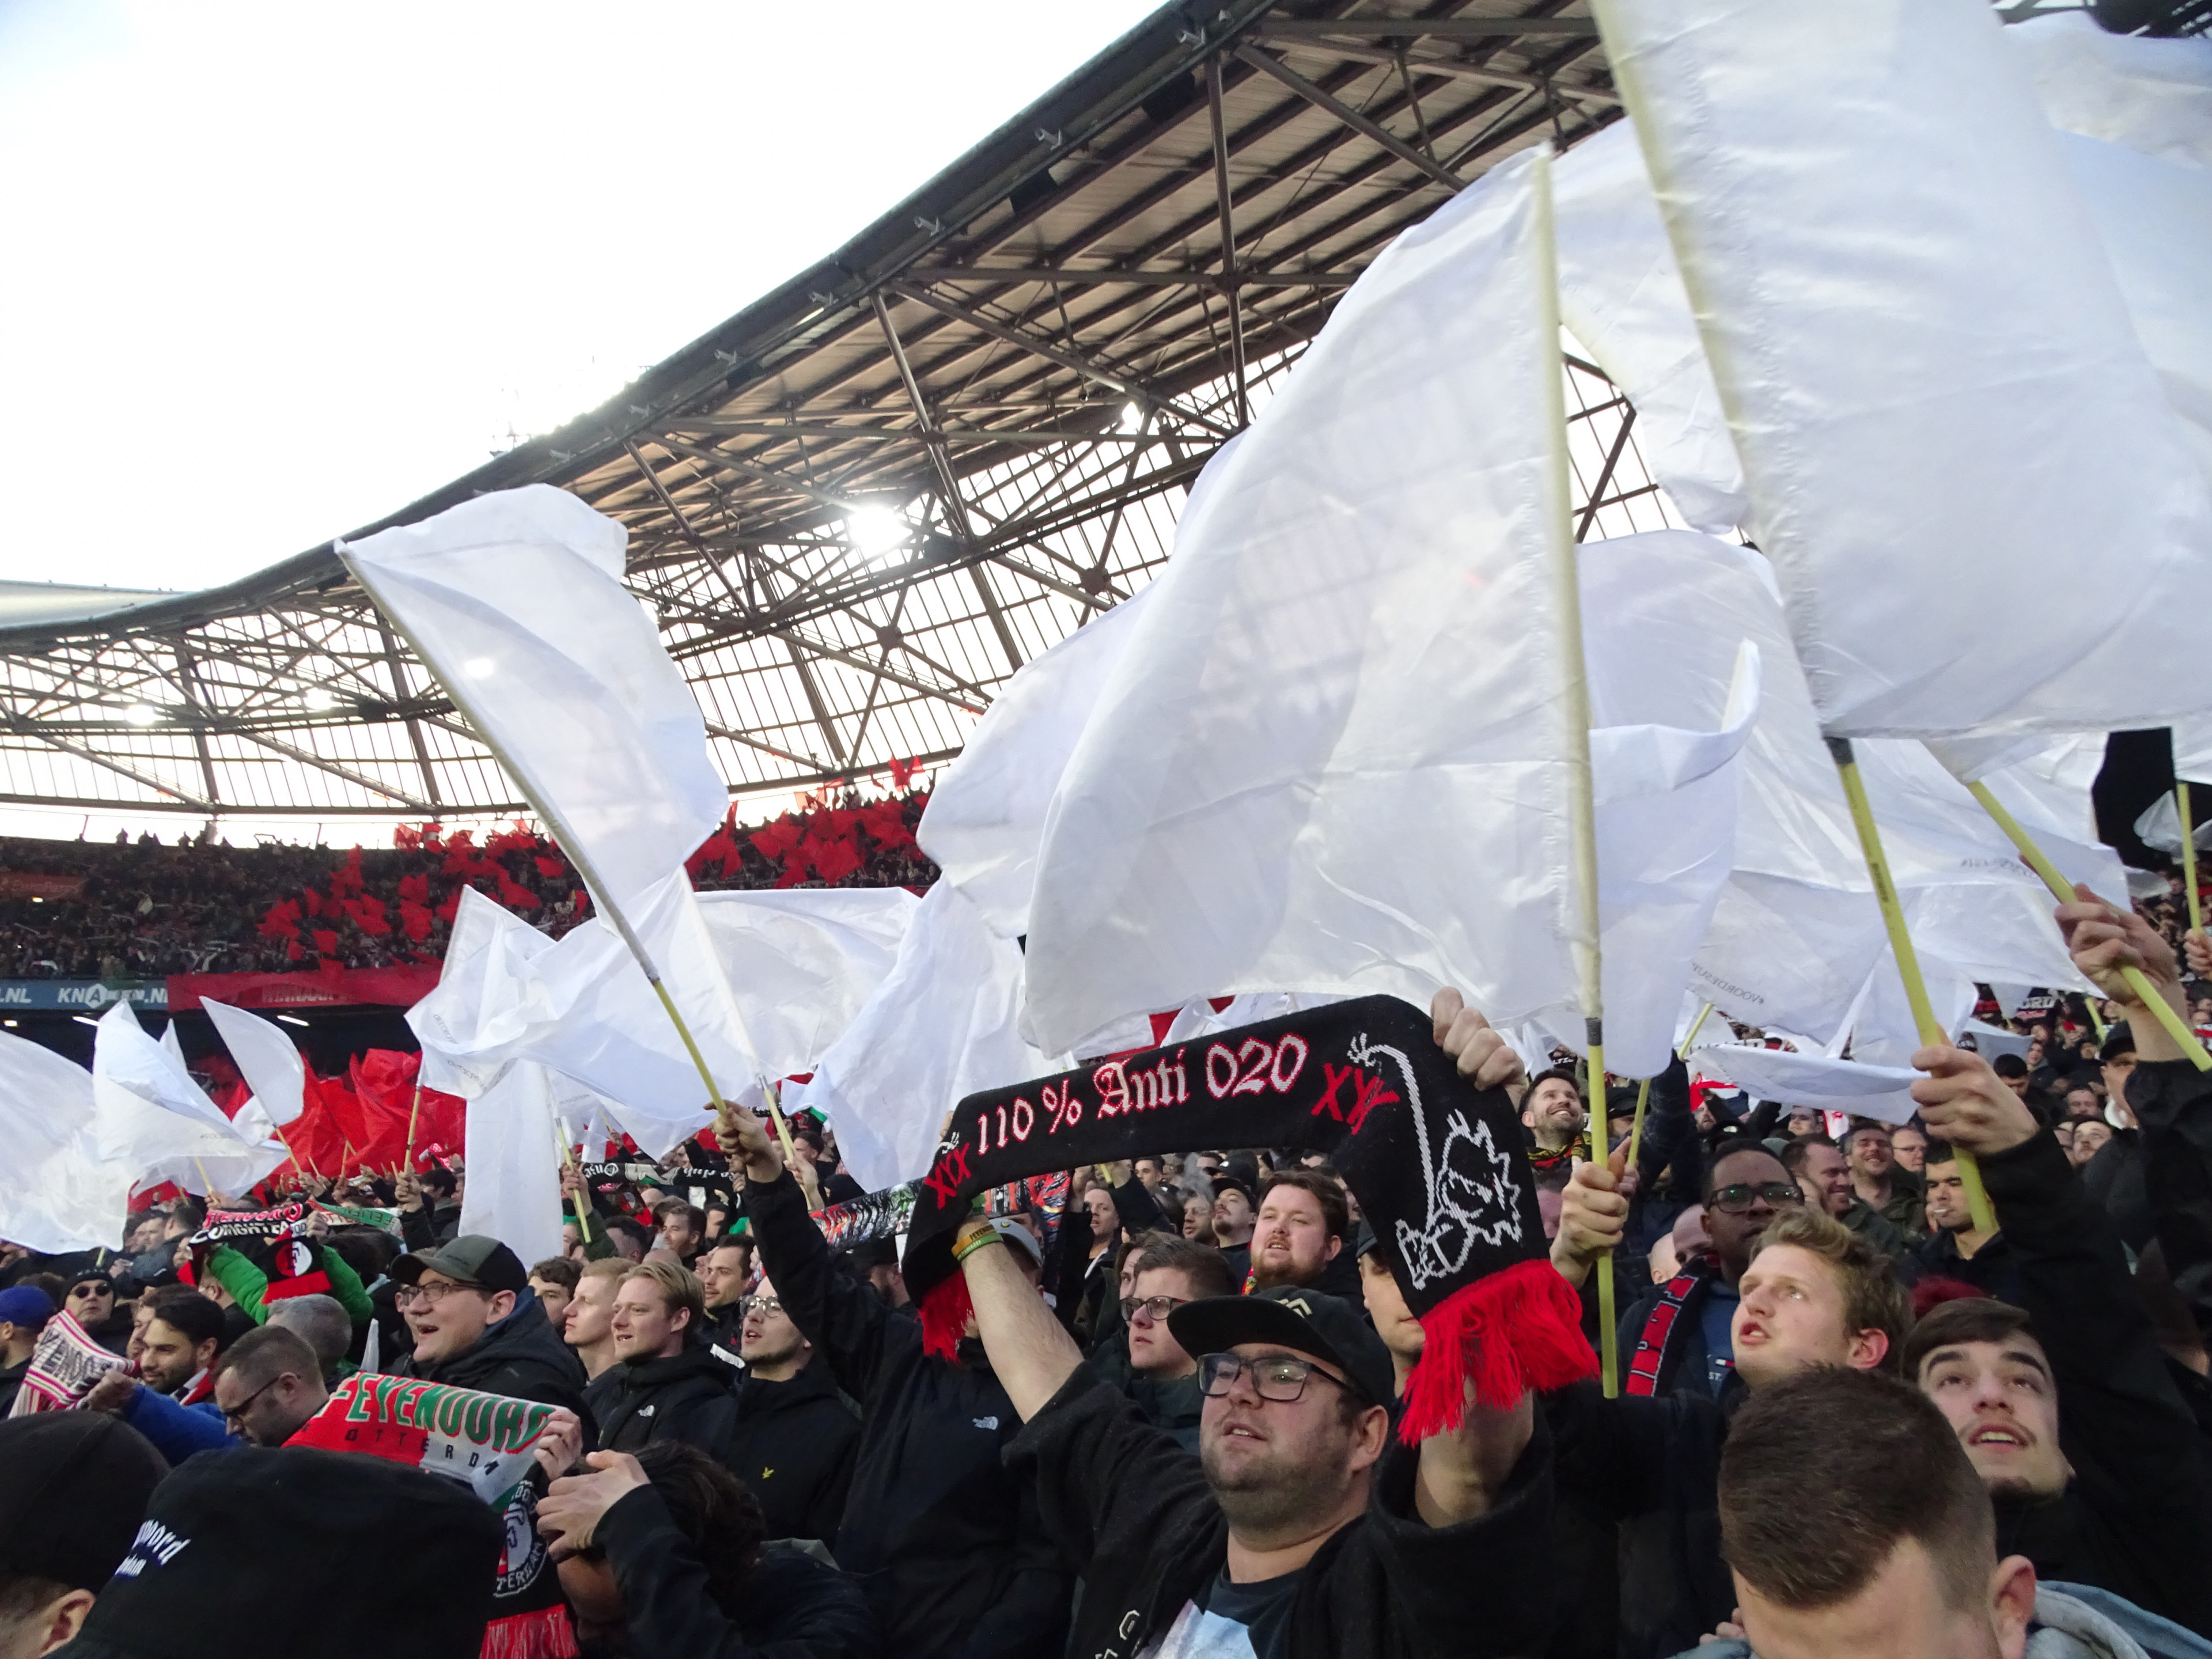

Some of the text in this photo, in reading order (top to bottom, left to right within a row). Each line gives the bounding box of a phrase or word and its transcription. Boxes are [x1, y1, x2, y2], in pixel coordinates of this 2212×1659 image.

[925, 1142, 971, 1209] XXX
[978, 1097, 1035, 1155] 110
[1042, 1078, 1083, 1134] %
[1093, 1047, 1190, 1119] Anti
[1206, 1033, 1309, 1099] 020
